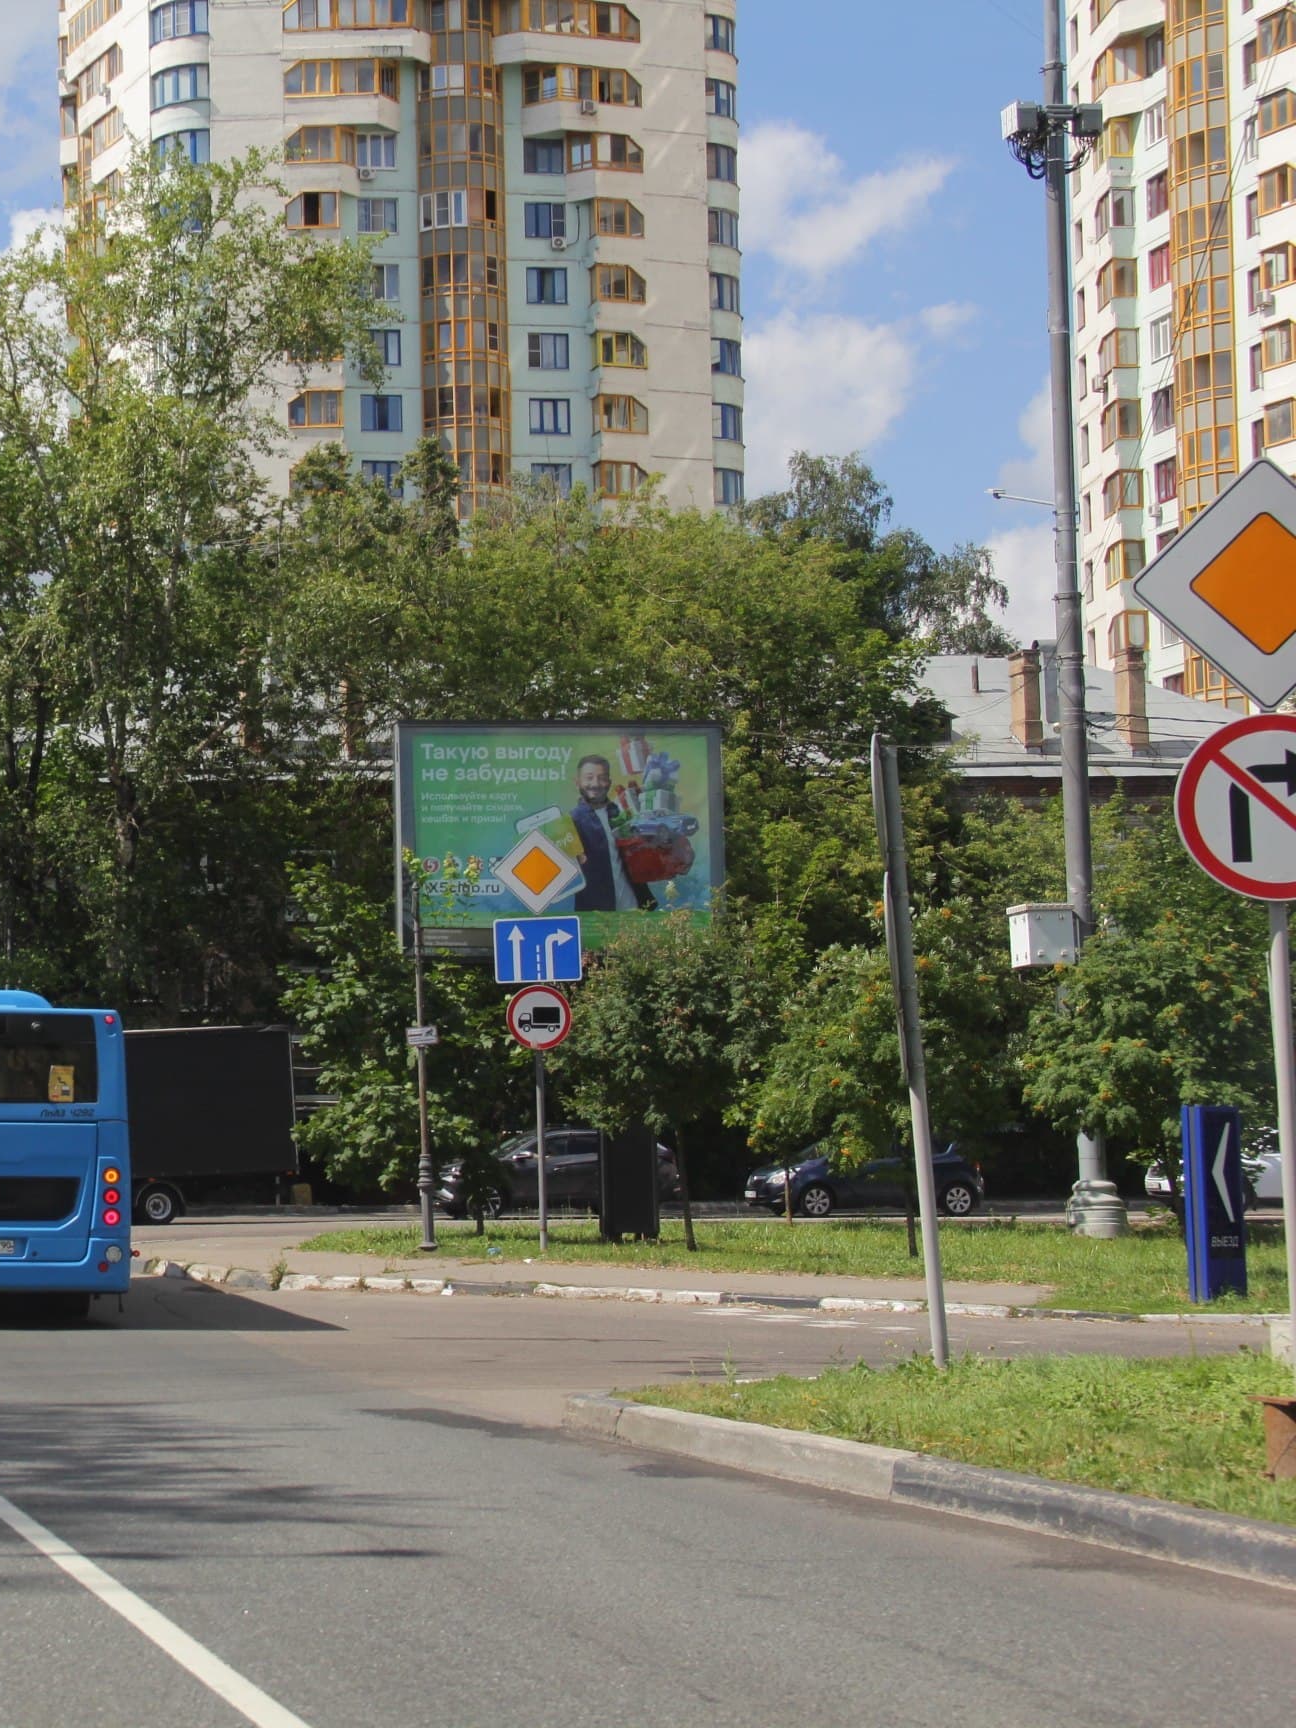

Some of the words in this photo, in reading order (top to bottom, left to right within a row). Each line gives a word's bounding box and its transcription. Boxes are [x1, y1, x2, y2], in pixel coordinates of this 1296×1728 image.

[420, 743, 489, 763] Такую
[495, 746, 573, 763] выгоду
[421, 767, 449, 781] не
[455, 764, 567, 784] забудешь!
[1211, 1235, 1239, 1247] ВЫЕЗД
